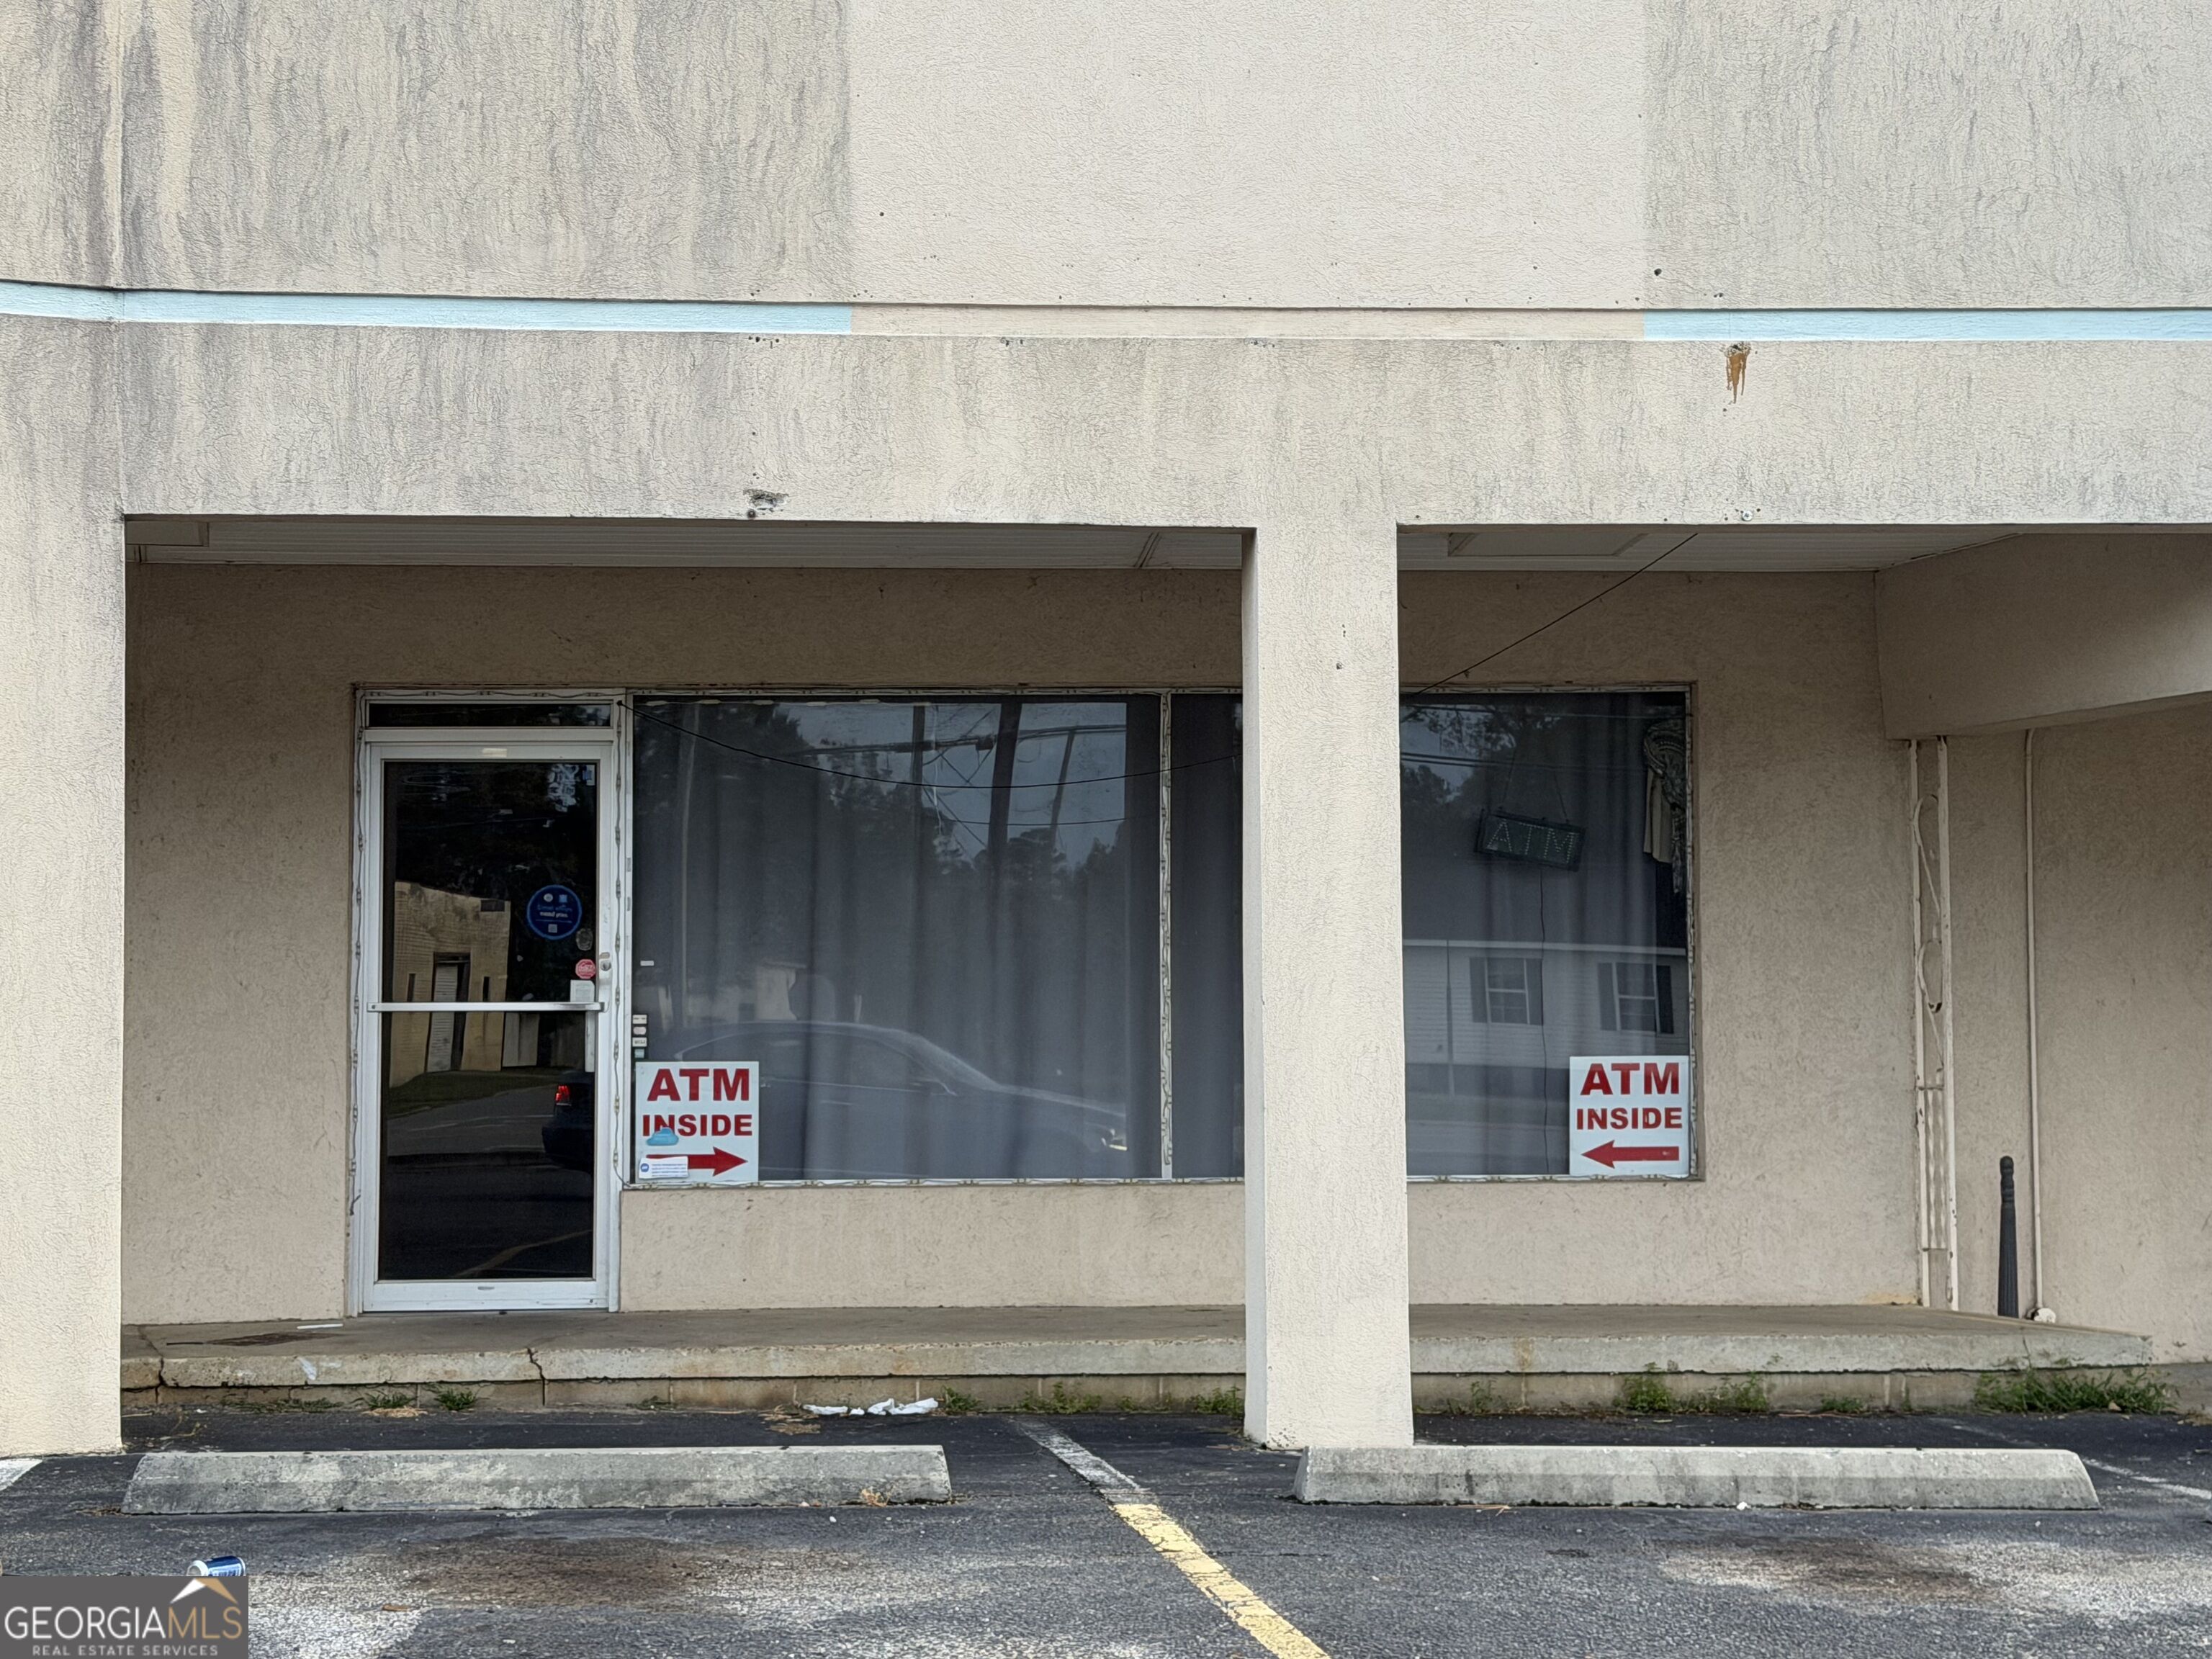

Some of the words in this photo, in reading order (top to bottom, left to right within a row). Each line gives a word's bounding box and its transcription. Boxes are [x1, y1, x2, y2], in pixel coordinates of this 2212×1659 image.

[1486, 818, 1575, 863] ATM
[647, 1068, 750, 1102] ATM
[1580, 1062, 1680, 1095] ATM
[642, 1114, 752, 1136] INSIDE
[1576, 1107, 1683, 1130] INSIDE
